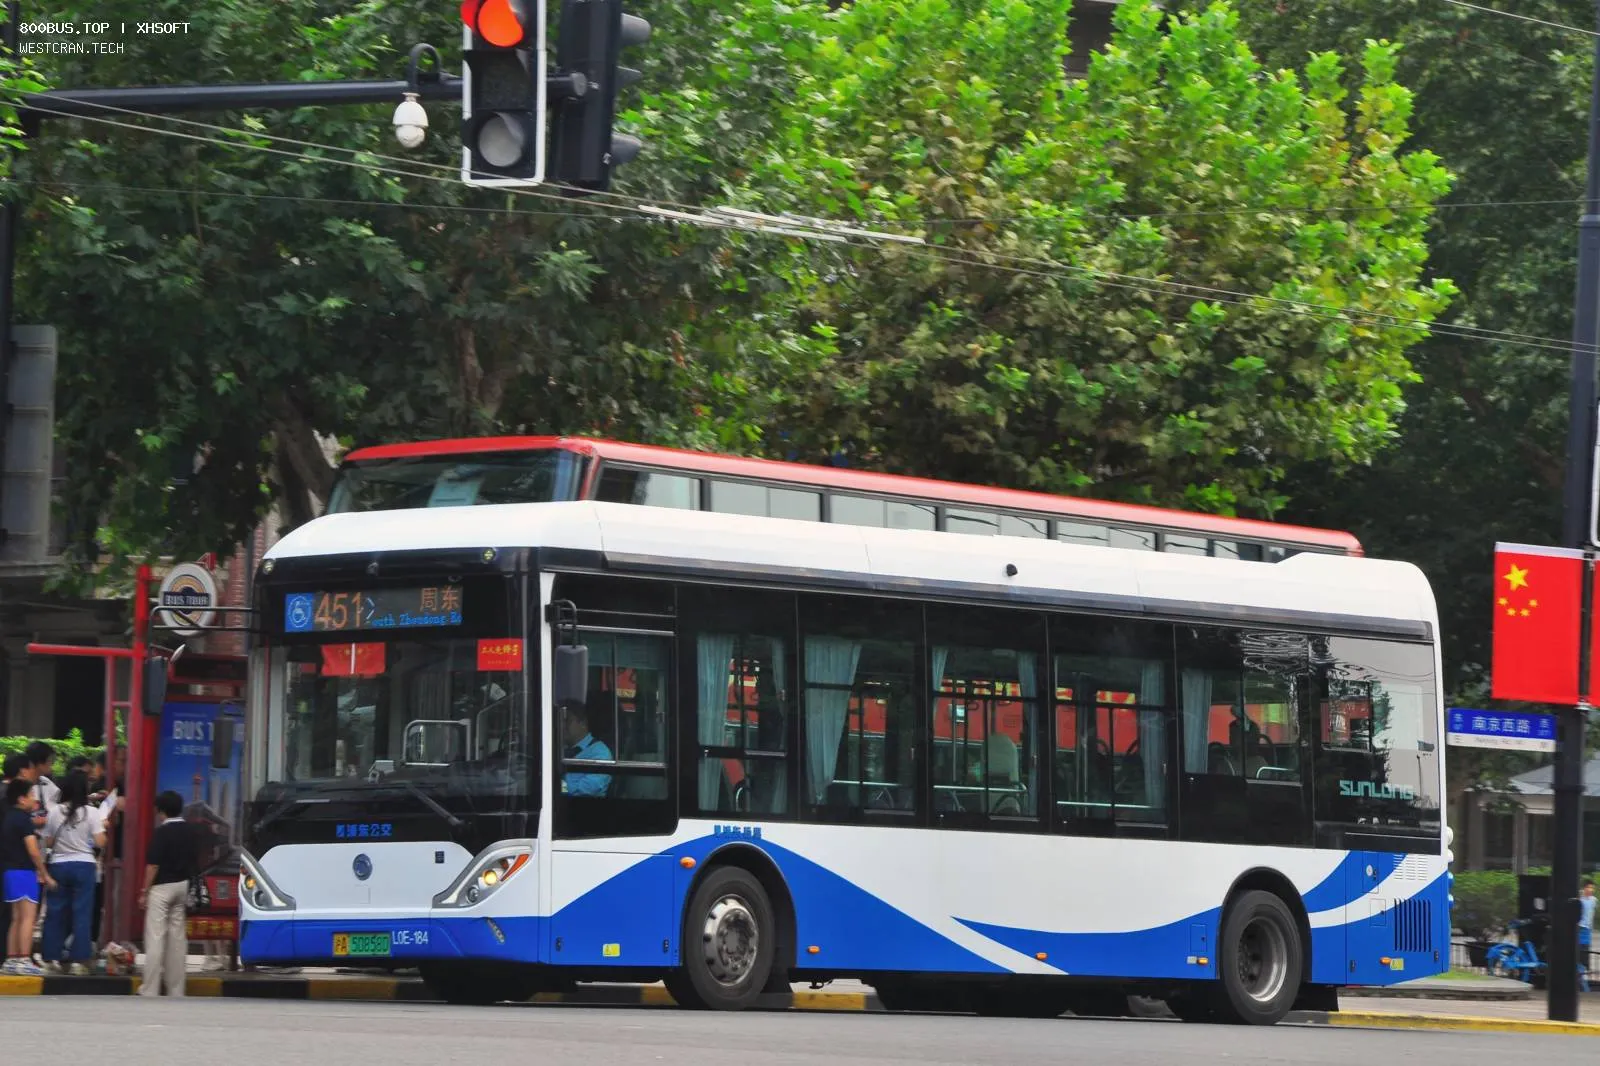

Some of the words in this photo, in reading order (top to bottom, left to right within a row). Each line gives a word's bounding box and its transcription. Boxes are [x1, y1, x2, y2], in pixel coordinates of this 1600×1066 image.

[314, 591, 363, 629] 451
[173, 720, 204, 740] BUS
[1471, 716, 1531, 735] 南京西路
[1339, 779, 1414, 800] SUNLONG
